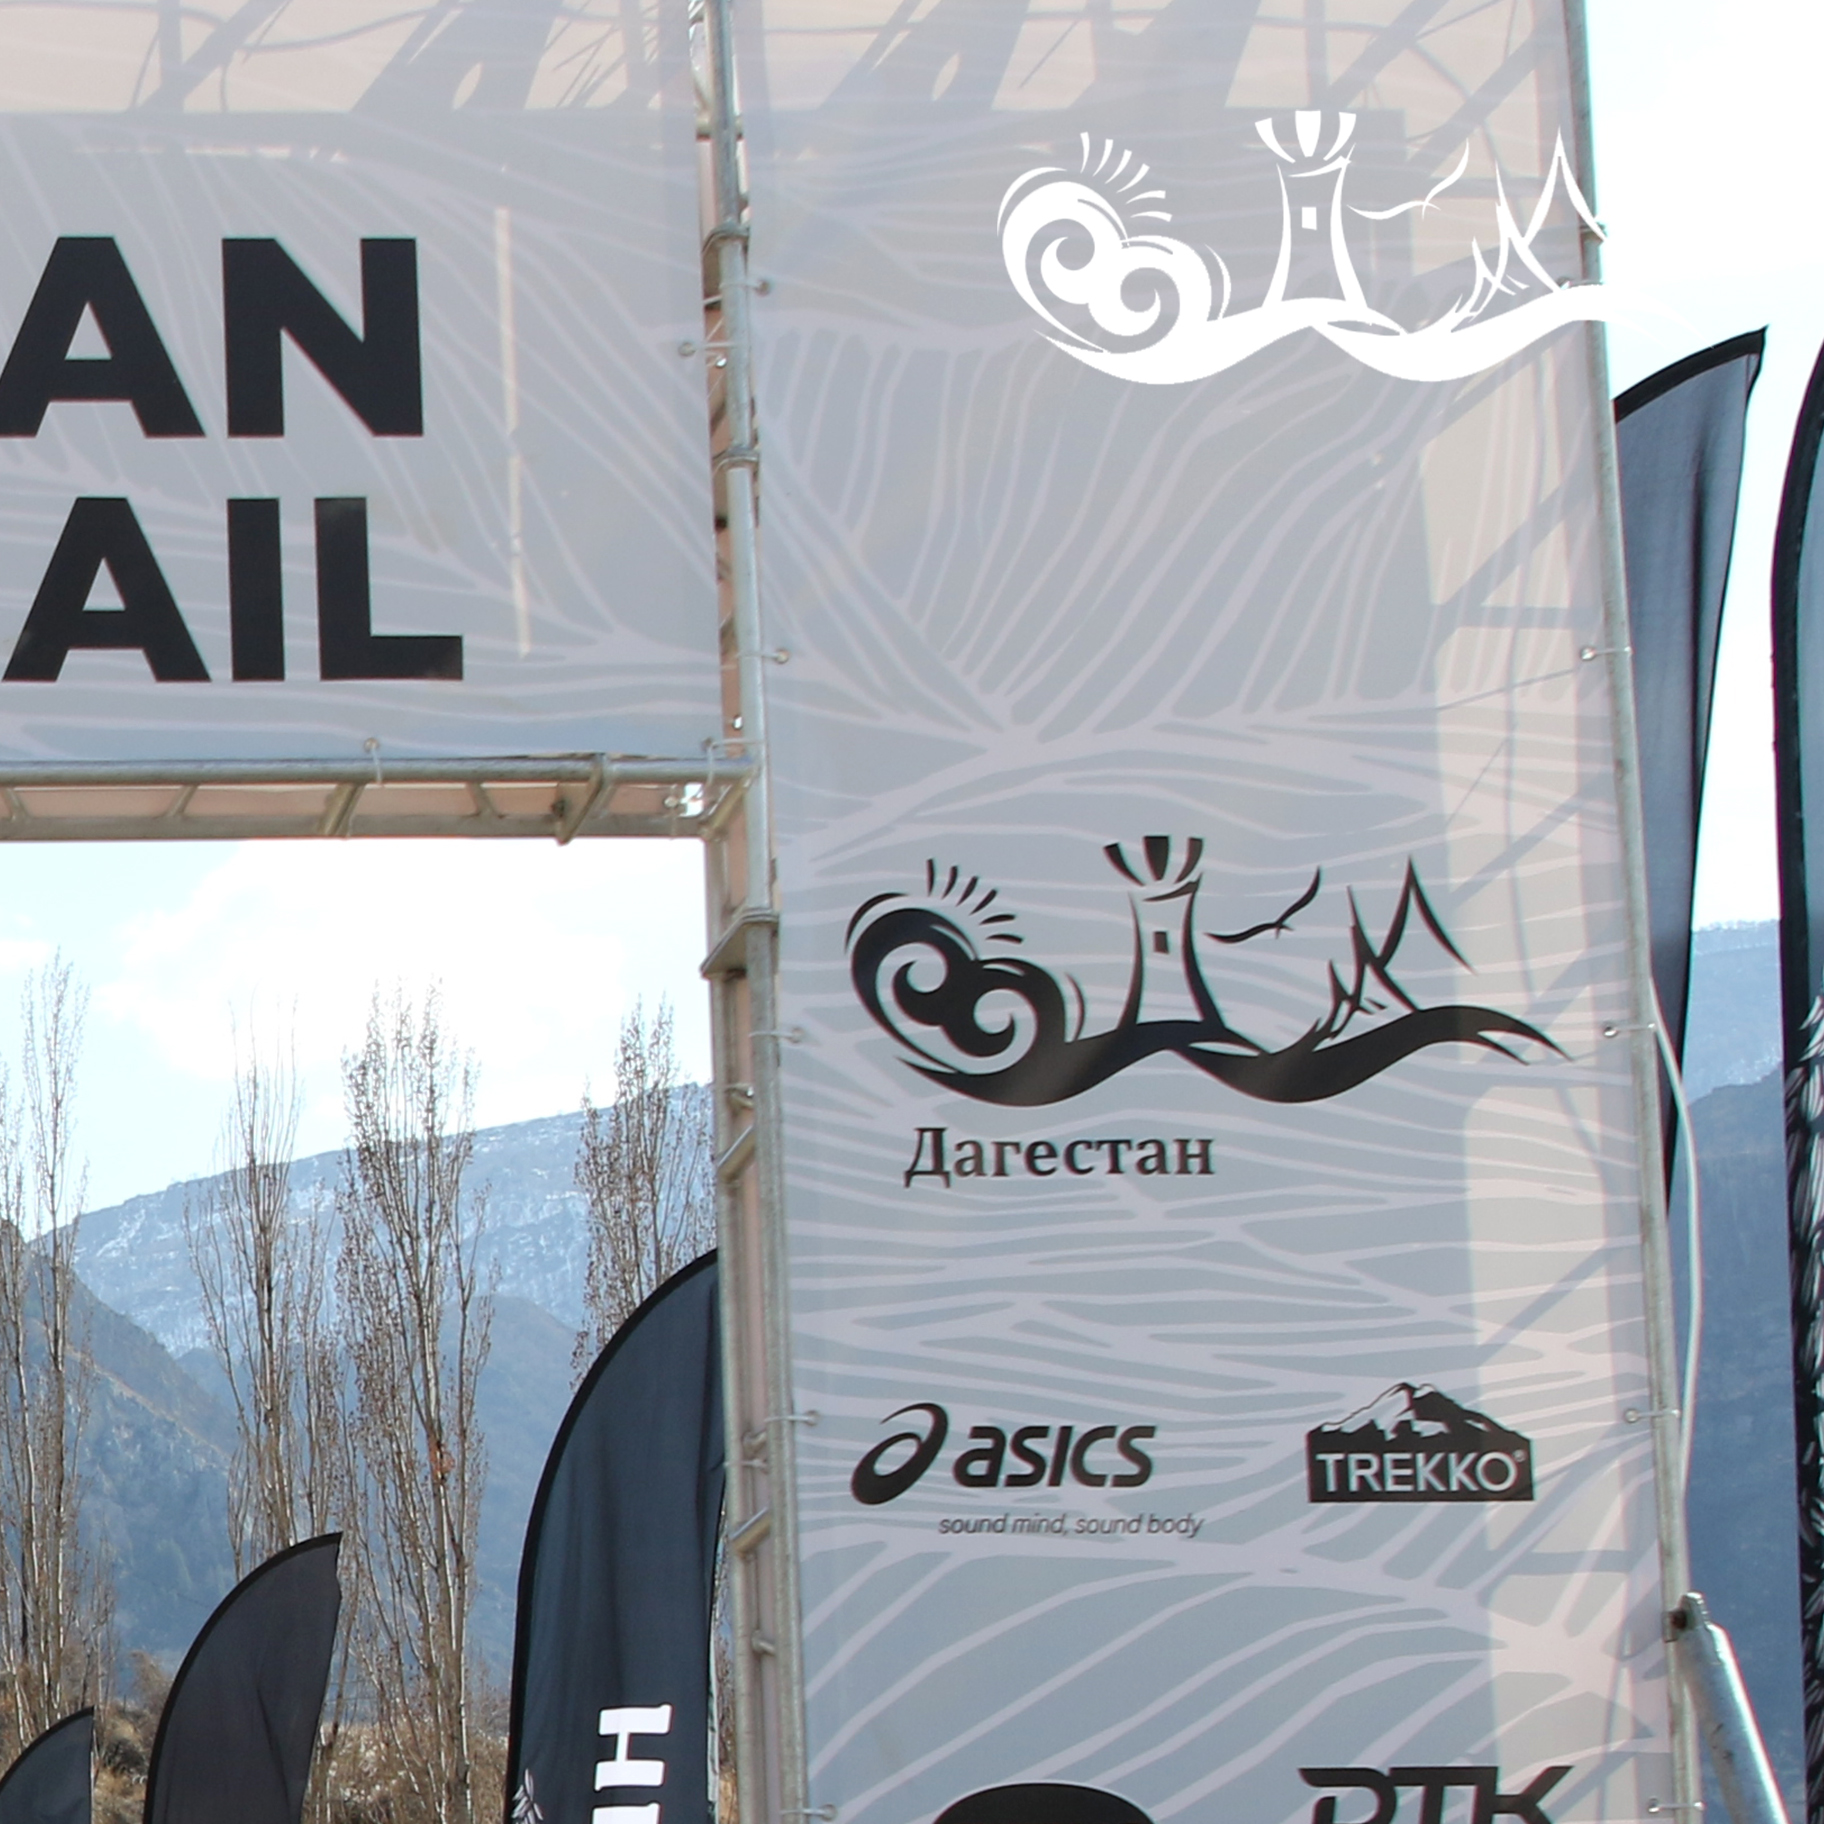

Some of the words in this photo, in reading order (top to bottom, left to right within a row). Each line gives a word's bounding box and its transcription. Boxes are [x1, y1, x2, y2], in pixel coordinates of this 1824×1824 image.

[903, 1126, 1216, 1189] Дагестан
[952, 1423, 1158, 1489] asics
[1315, 1450, 1519, 1494] TREKKO
[938, 1512, 1007, 1537] sound
[1011, 1512, 1070, 1541] mind,
[1074, 1512, 1143, 1537] sound
[1147, 1512, 1204, 1541] body
